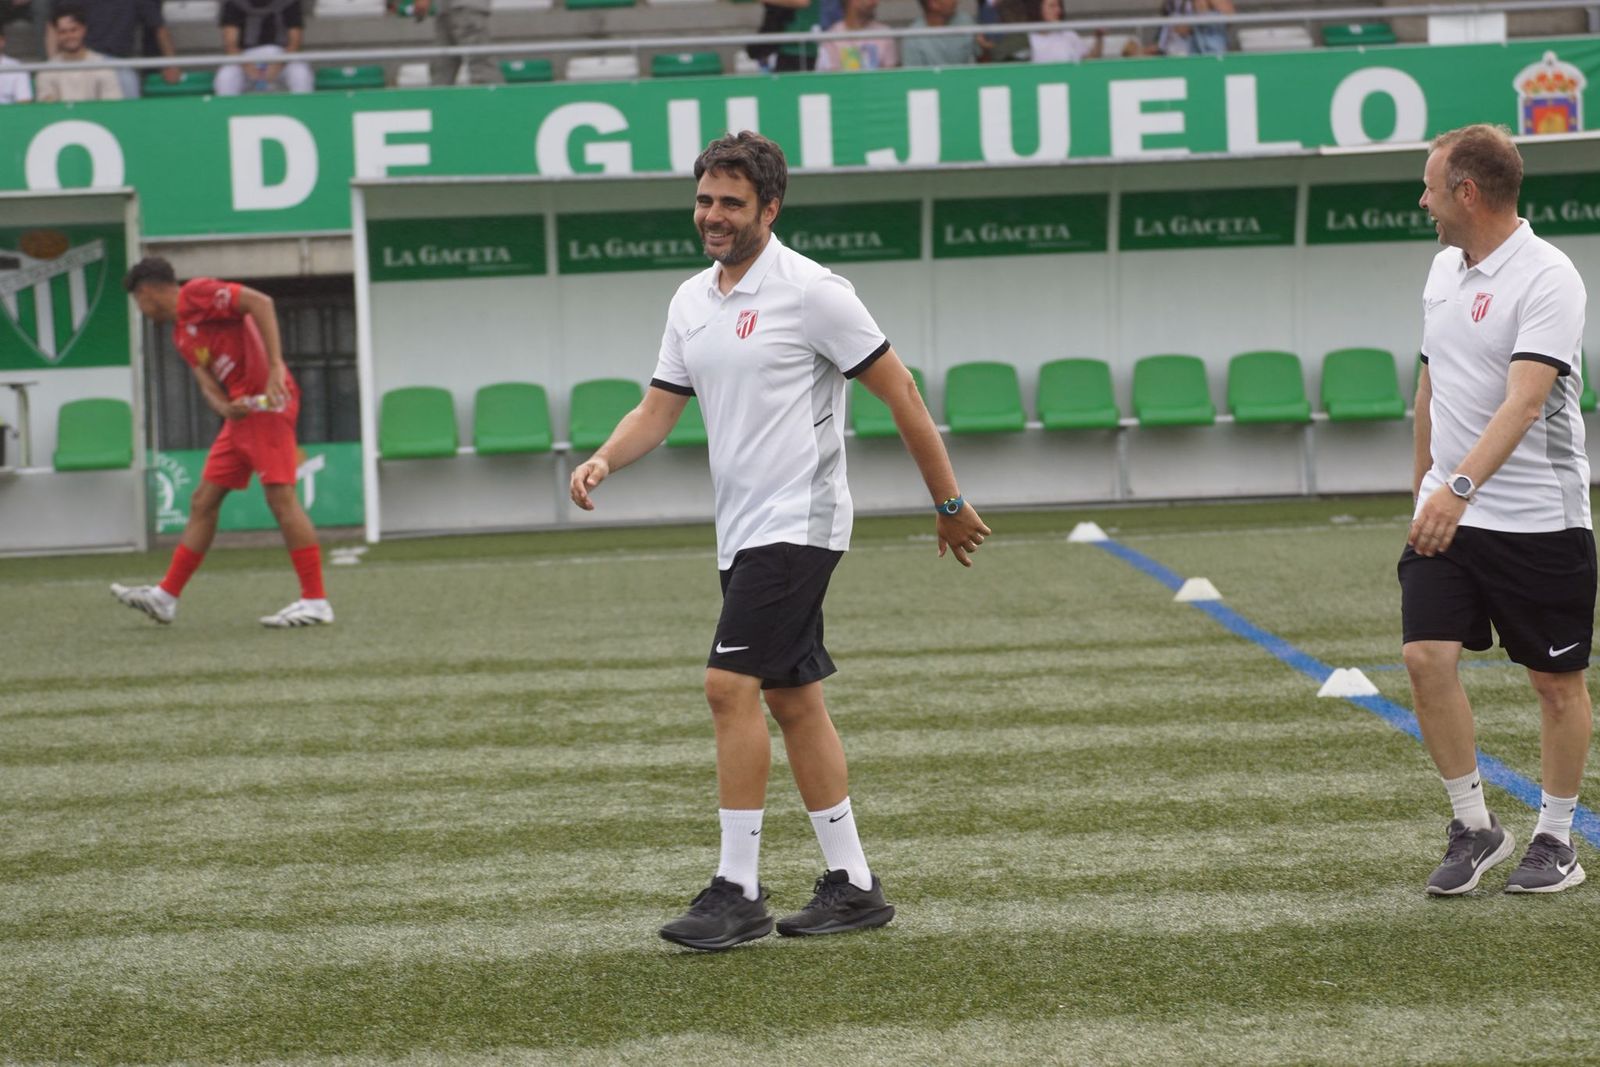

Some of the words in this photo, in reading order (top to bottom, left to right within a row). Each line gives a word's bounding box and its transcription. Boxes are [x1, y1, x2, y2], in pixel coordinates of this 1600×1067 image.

[228, 109, 433, 212] DE
[1326, 209, 1358, 230] LA
[1361, 208, 1433, 228] GACE
[1525, 203, 1557, 223] LA
[944, 225, 976, 245] LA
[979, 222, 1071, 243] GACETA
[1134, 217, 1166, 237] LA
[1169, 215, 1261, 235] GACETA
[569, 240, 601, 260] LA
[604, 238, 697, 258] GACETA
[791, 230, 882, 250] GACETA
[384, 247, 416, 267] LA
[419, 245, 511, 265] GACETA
